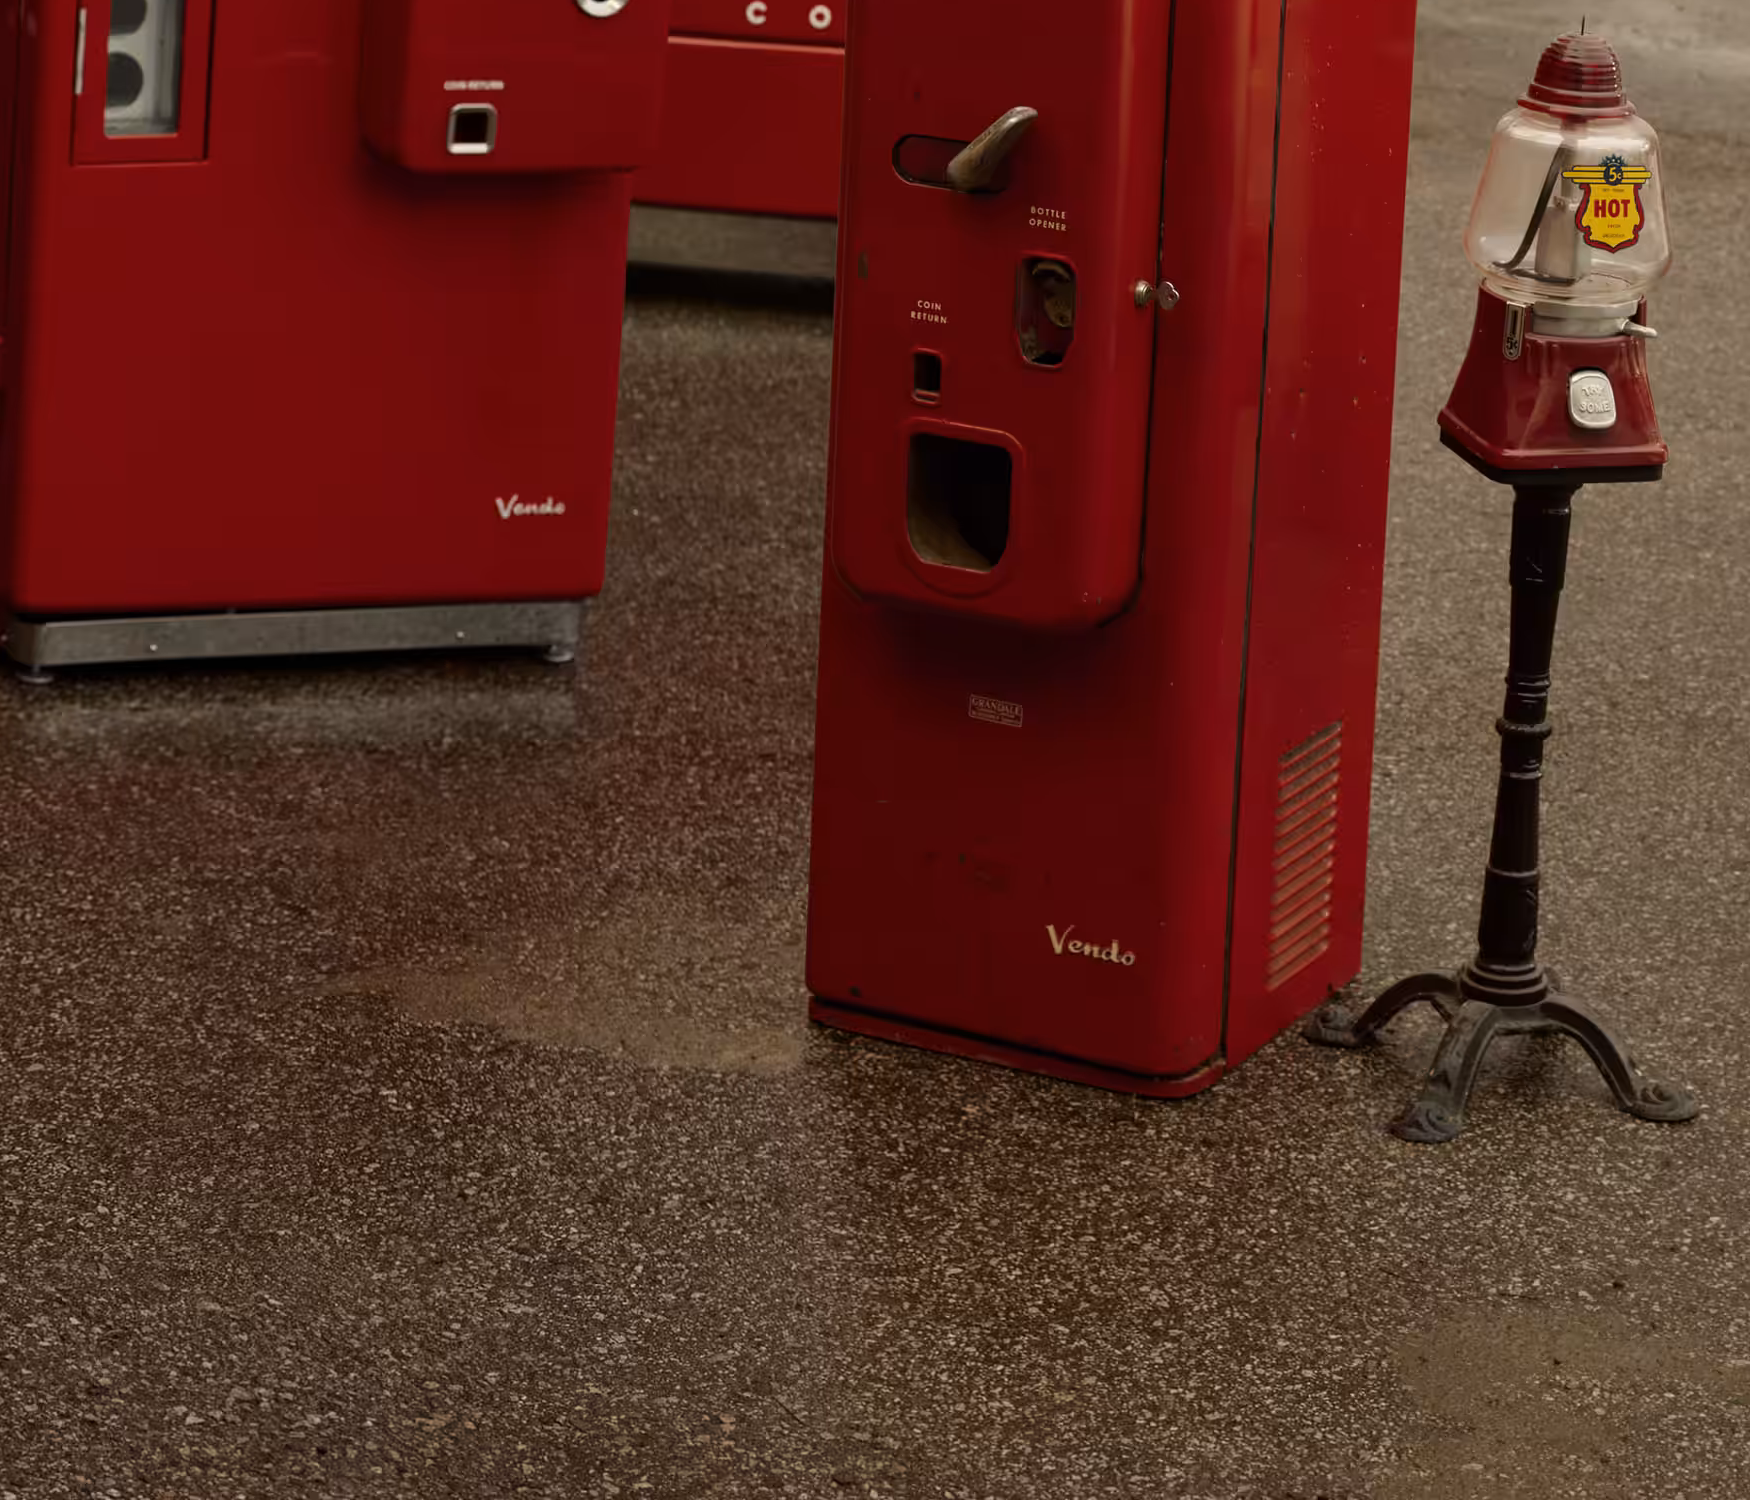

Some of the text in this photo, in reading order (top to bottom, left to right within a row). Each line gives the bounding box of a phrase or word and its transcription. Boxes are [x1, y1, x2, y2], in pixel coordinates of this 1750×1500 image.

[1030, 205, 1066, 219] BOTTLE
[1594, 199, 1631, 218] HOT
[1029, 218, 1067, 231] OPENER
[917, 299, 942, 311] COIN
[910, 310, 947, 324] RETURN
[1581, 384, 1603, 398] TRY
[1580, 401, 1610, 415] SOME
[495, 494, 566, 519] Vendo
[1046, 924, 1136, 966] Vendo
